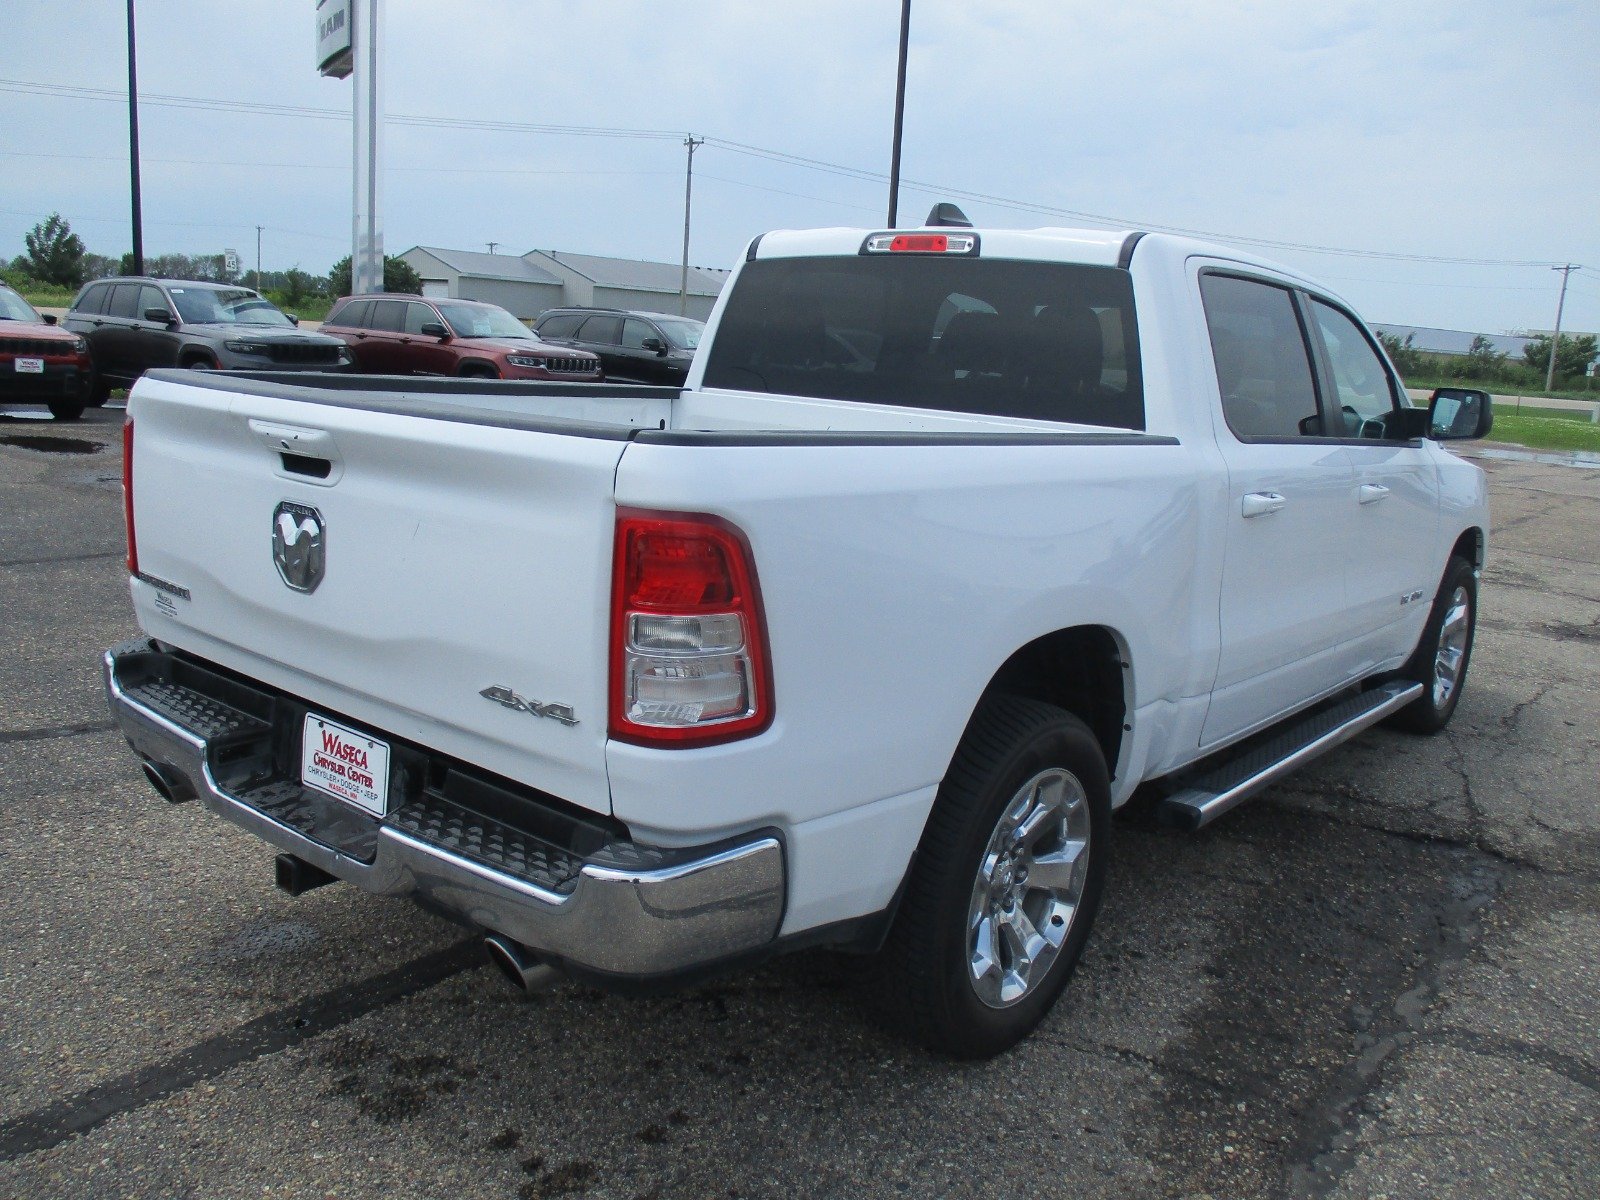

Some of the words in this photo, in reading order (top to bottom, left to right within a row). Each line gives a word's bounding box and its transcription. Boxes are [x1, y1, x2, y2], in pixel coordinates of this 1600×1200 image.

[322, 729, 368, 769] WASECA
[313, 752, 346, 777] CHRYSLER
[347, 766, 373, 789] CENTER
[340, 779, 360, 794] DODGE
[364, 790, 378, 801] JEEP
